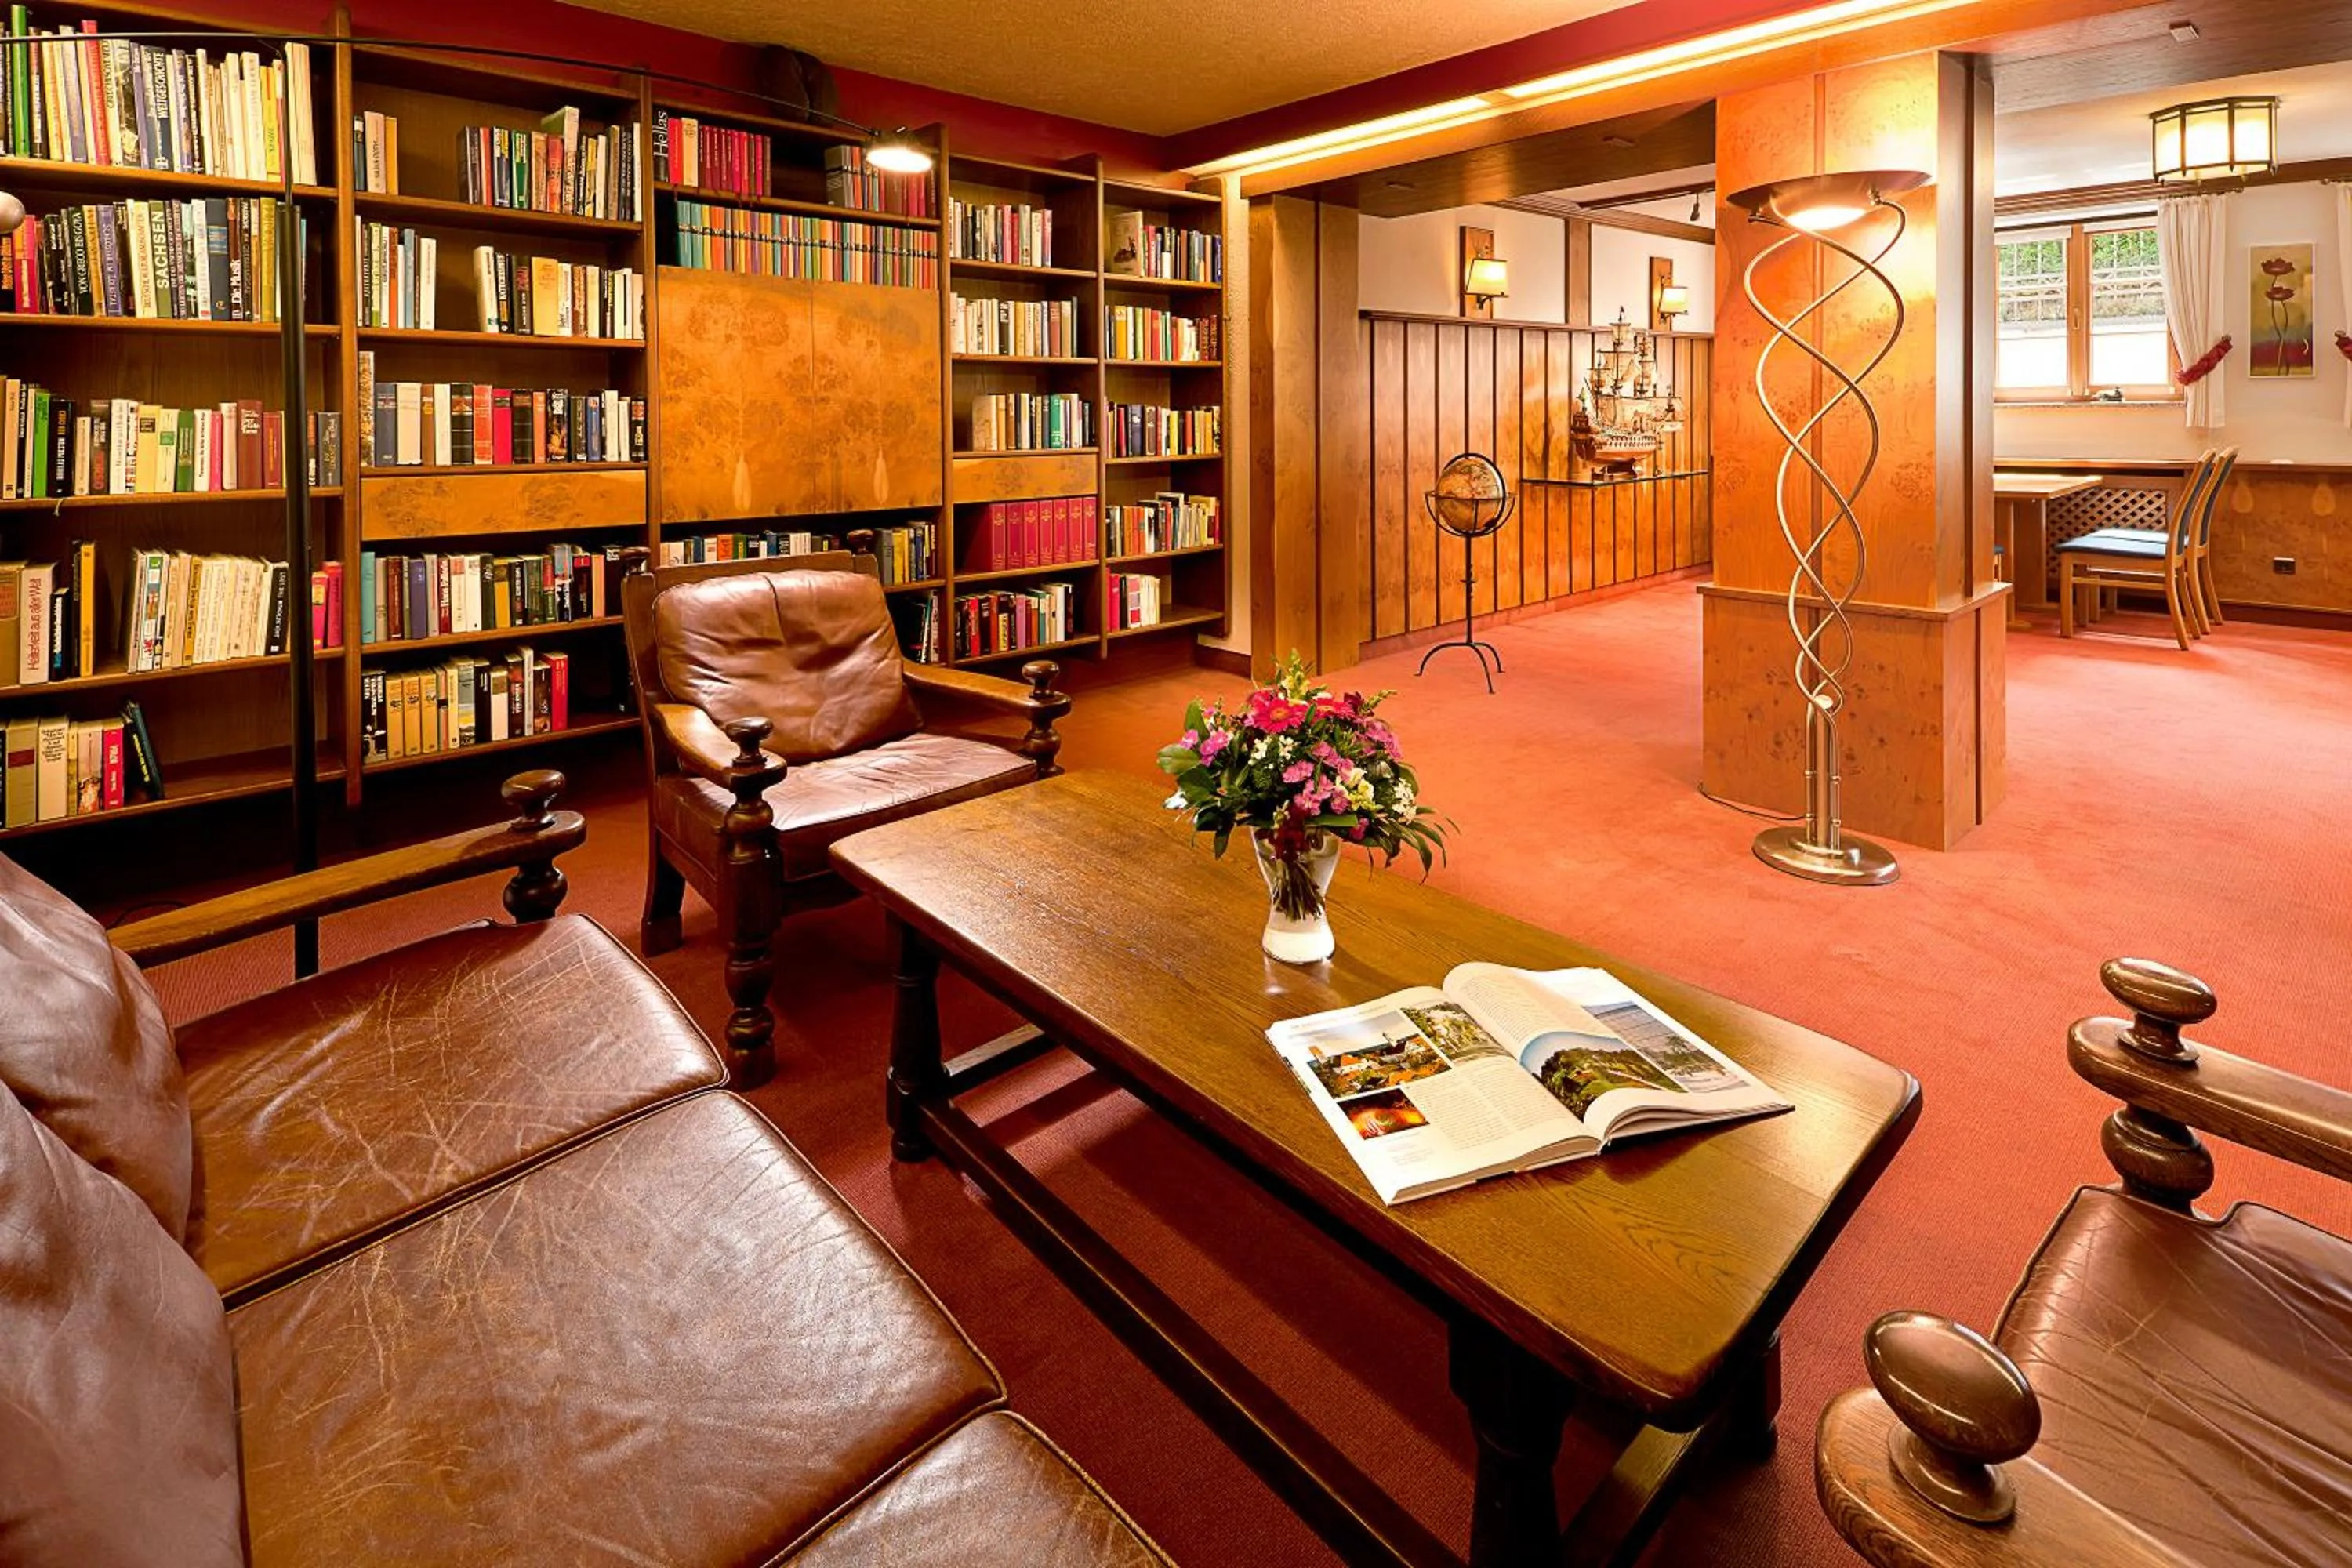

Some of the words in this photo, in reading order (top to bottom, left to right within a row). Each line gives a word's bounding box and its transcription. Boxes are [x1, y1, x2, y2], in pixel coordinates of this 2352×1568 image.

[153, 53, 168, 118] WELTGESCHICHTE
[652, 111, 669, 157] Hellas
[72, 212, 82, 234] GOYA
[151, 211, 169, 289] SACHSEN
[75, 249, 87, 277] GRECO
[230, 259, 241, 286] Musik
[78, 277, 88, 294] VON
[231, 288, 241, 303] Die
[29, 578, 42, 596] Welt
[28, 597, 41, 613] aller
[31, 614, 40, 630] aus
[27, 630, 40, 670] Heiterkeit
